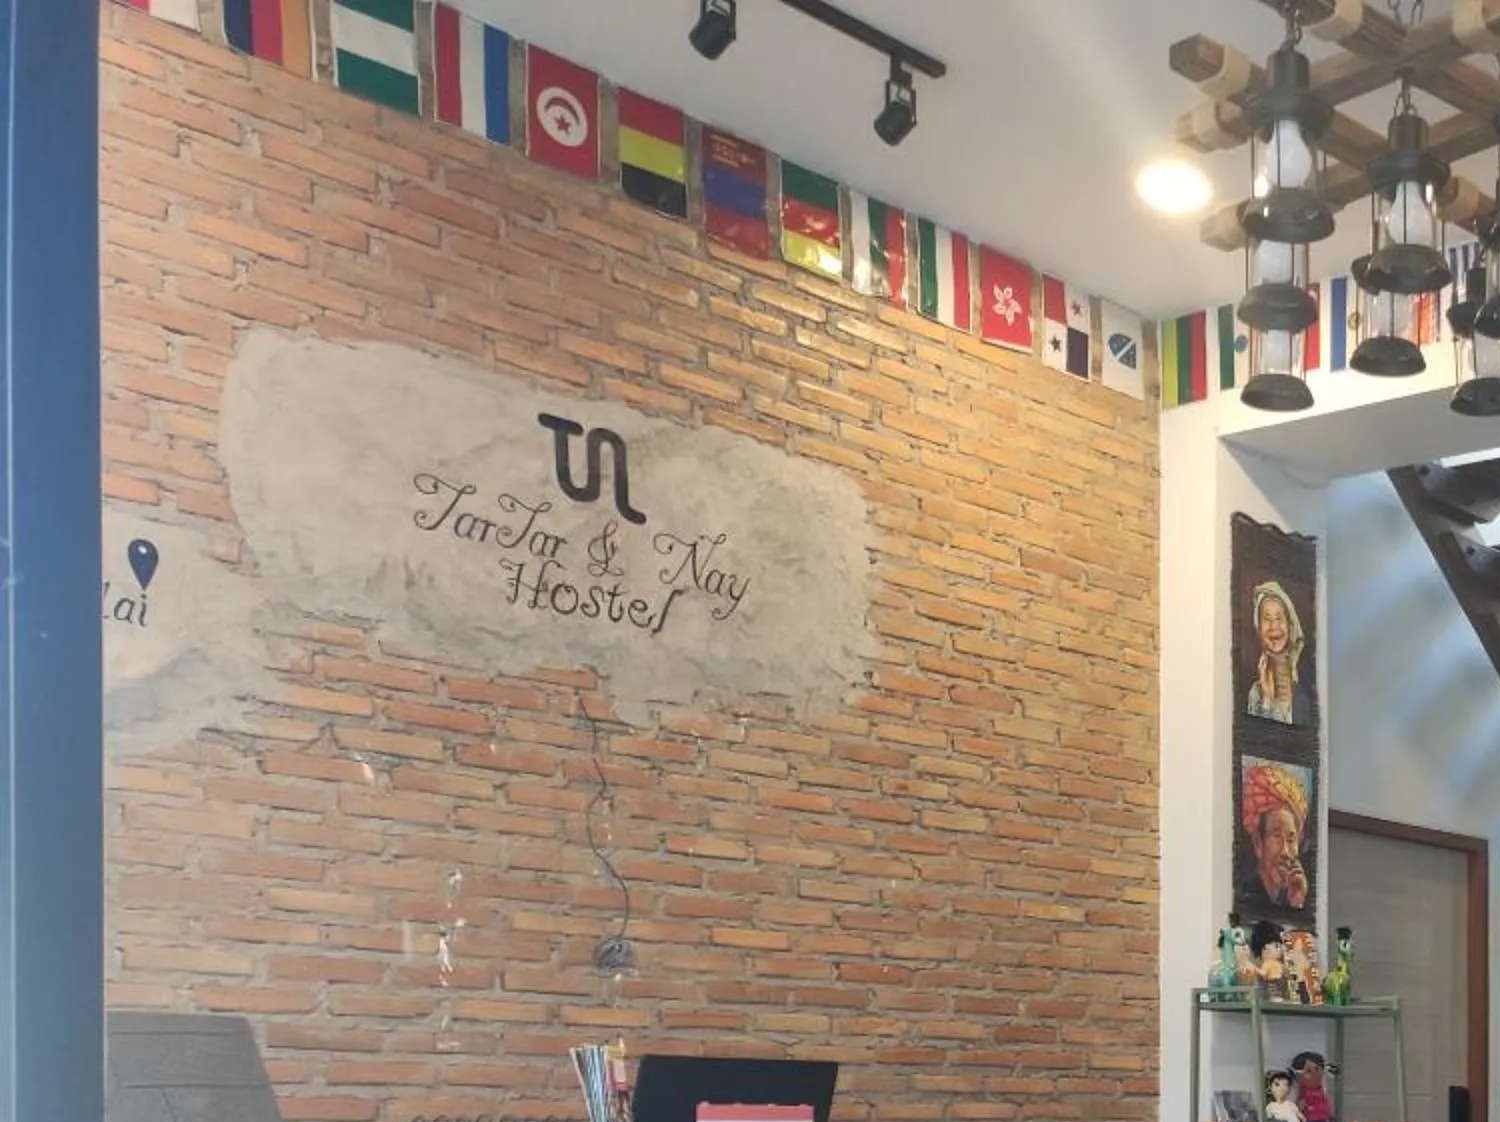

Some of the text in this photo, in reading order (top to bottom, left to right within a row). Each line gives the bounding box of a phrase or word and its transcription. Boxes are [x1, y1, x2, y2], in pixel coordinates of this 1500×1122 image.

[102, 580, 149, 628] ai
[500, 558, 684, 634] Hostel
[587, 519, 624, 577] &
[653, 532, 751, 620] Nay
